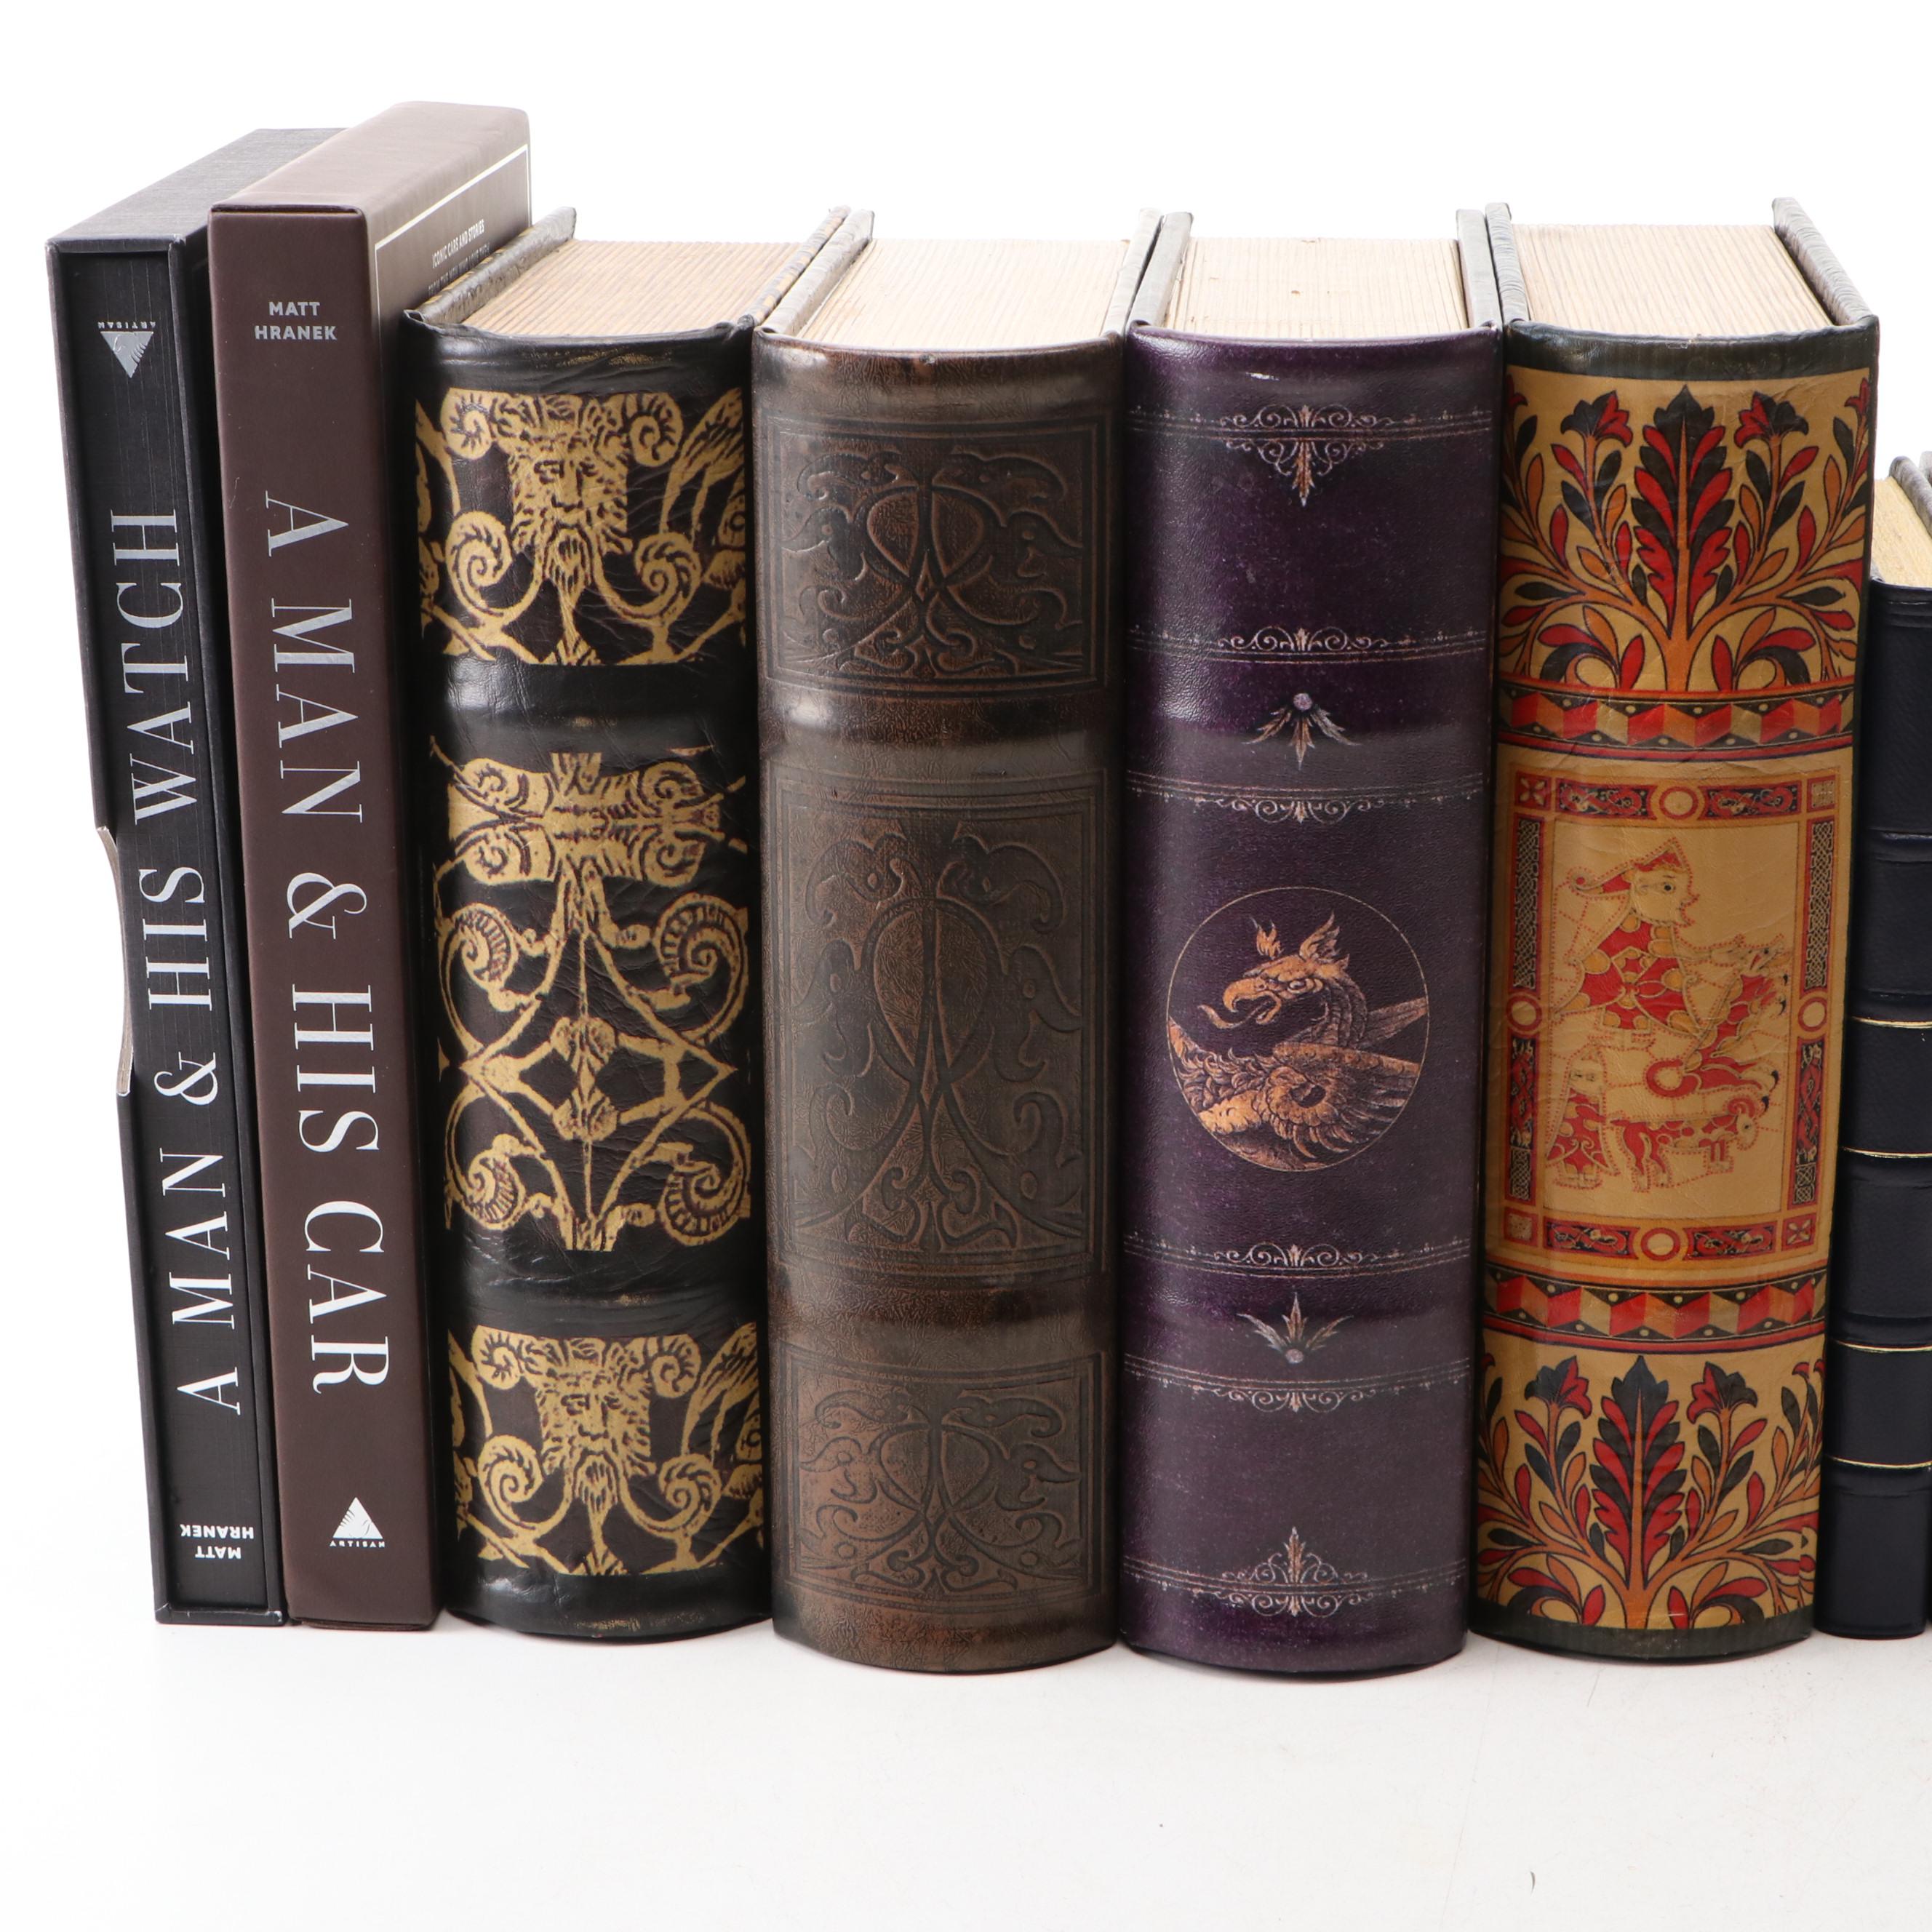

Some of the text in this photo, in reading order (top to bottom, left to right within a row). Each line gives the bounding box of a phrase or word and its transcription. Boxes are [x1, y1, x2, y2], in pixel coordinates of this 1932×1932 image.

[447, 237, 459, 257] CARS
[459, 231, 468, 250] AND
[468, 219, 484, 242] STORIES
[268, 301, 321, 316] MATT
[97, 321, 156, 330] ARTISAN
[254, 325, 337, 340] HRANEK
[265, 490, 390, 1394] A MAN & HIS CAR
[110, 508, 242, 1416] A MAN & HIS WATCH
[179, 1523, 255, 1540] HRANEK
[329, 1540, 386, 1548] ARTISAN
[194, 1545, 242, 1560] MATT
